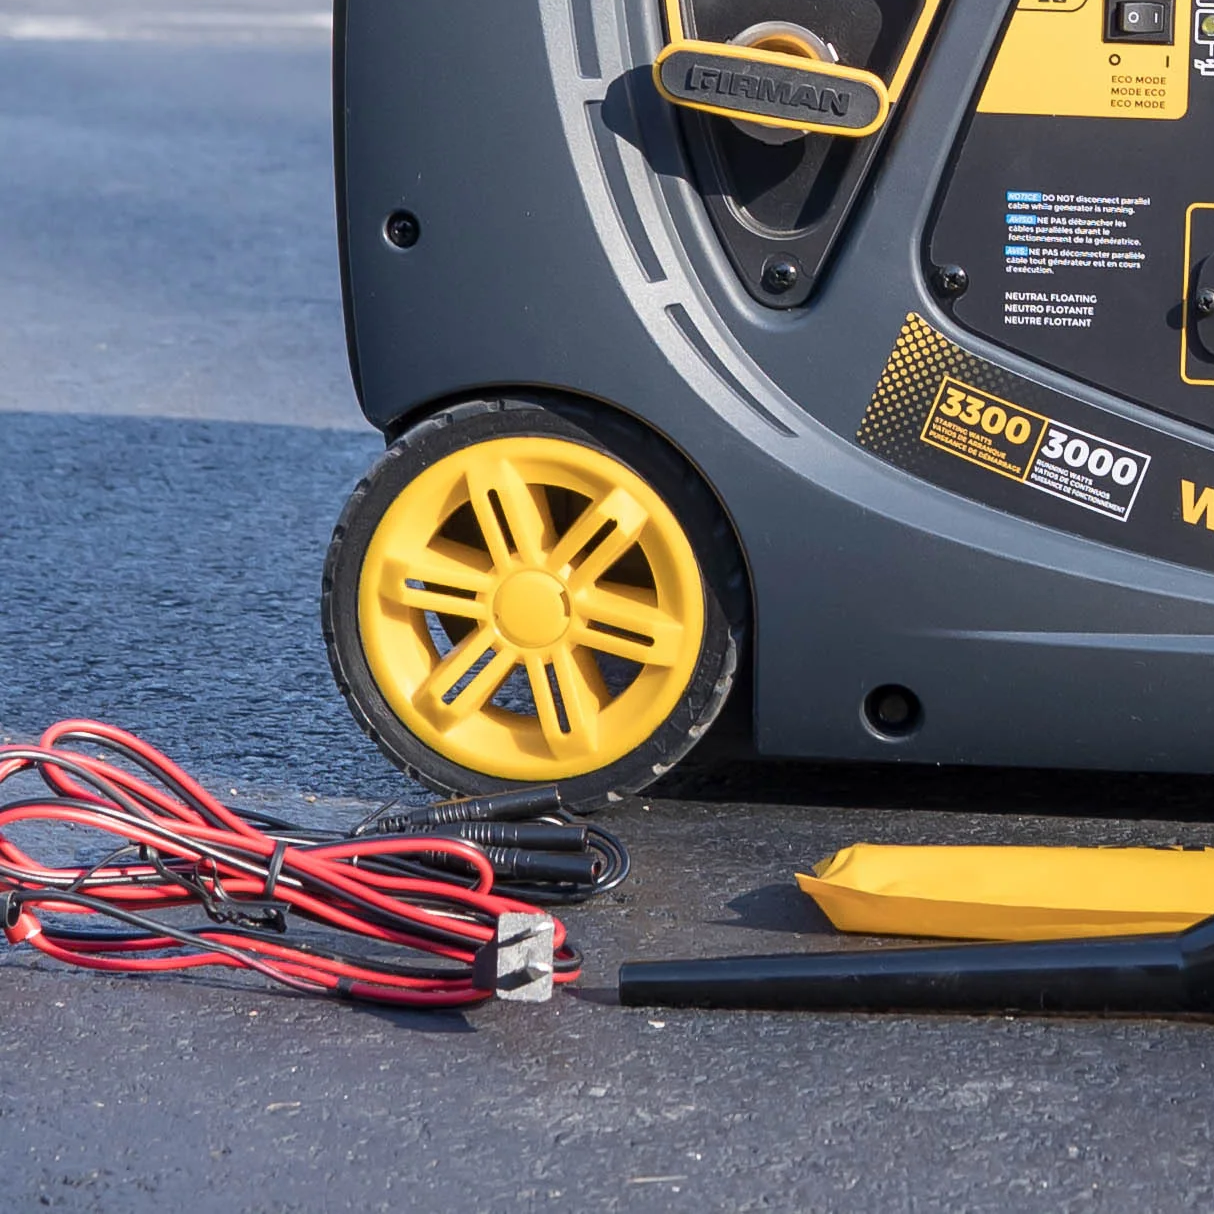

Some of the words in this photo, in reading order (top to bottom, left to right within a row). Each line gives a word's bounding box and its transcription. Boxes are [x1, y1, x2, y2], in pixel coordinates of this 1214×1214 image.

[1110, 75, 1133, 85] ECO
[1135, 75, 1167, 85] MODE
[685, 64, 851, 117] FIRMAN
[1110, 87, 1142, 97] MODE
[1144, 88, 1167, 97] ECO
[1110, 99, 1132, 108] ECO
[1134, 99, 1166, 109] MODE
[1042, 194, 1055, 202] DO
[1056, 194, 1075, 203] NOT
[1076, 195, 1120, 204] disconnect
[1120, 196, 1151, 206] parallel
[1031, 202, 1053, 211] while
[1054, 204, 1094, 214] generator
[1094, 205, 1102, 213] is
[1102, 205, 1136, 216] running.
[1037, 216, 1049, 225] NE
[1050, 216, 1067, 226] PAS
[1115, 218, 1127, 228] les
[1074, 227, 1102, 236] durant
[1102, 227, 1111, 236] le
[1007, 233, 1072, 244] fonctionnement
[1073, 235, 1084, 244] de
[1085, 235, 1093, 244] la
[1028, 248, 1040, 256] NE
[1041, 248, 1059, 257] PAS
[1029, 257, 1046, 266] tout
[1092, 259, 1106, 268] est
[1106, 260, 1117, 268] en
[1118, 260, 1141, 269] cours
[1005, 291, 1049, 302] NEUTRAL
[1050, 293, 1098, 304] FLOATING
[1004, 303, 1045, 314] NEUTRO
[1045, 305, 1094, 316] FLOTANTE
[1004, 316, 1042, 326] NEUTRE
[1043, 317, 1092, 328] FLOTTANT
[939, 387, 1032, 445] 3300
[934, 416, 969, 436] STARTING
[968, 428, 993, 446] WATTS
[1040, 428, 1138, 486] 3000
[1036, 458, 1069, 477] RUNNING
[1069, 470, 1094, 486] WATTS
